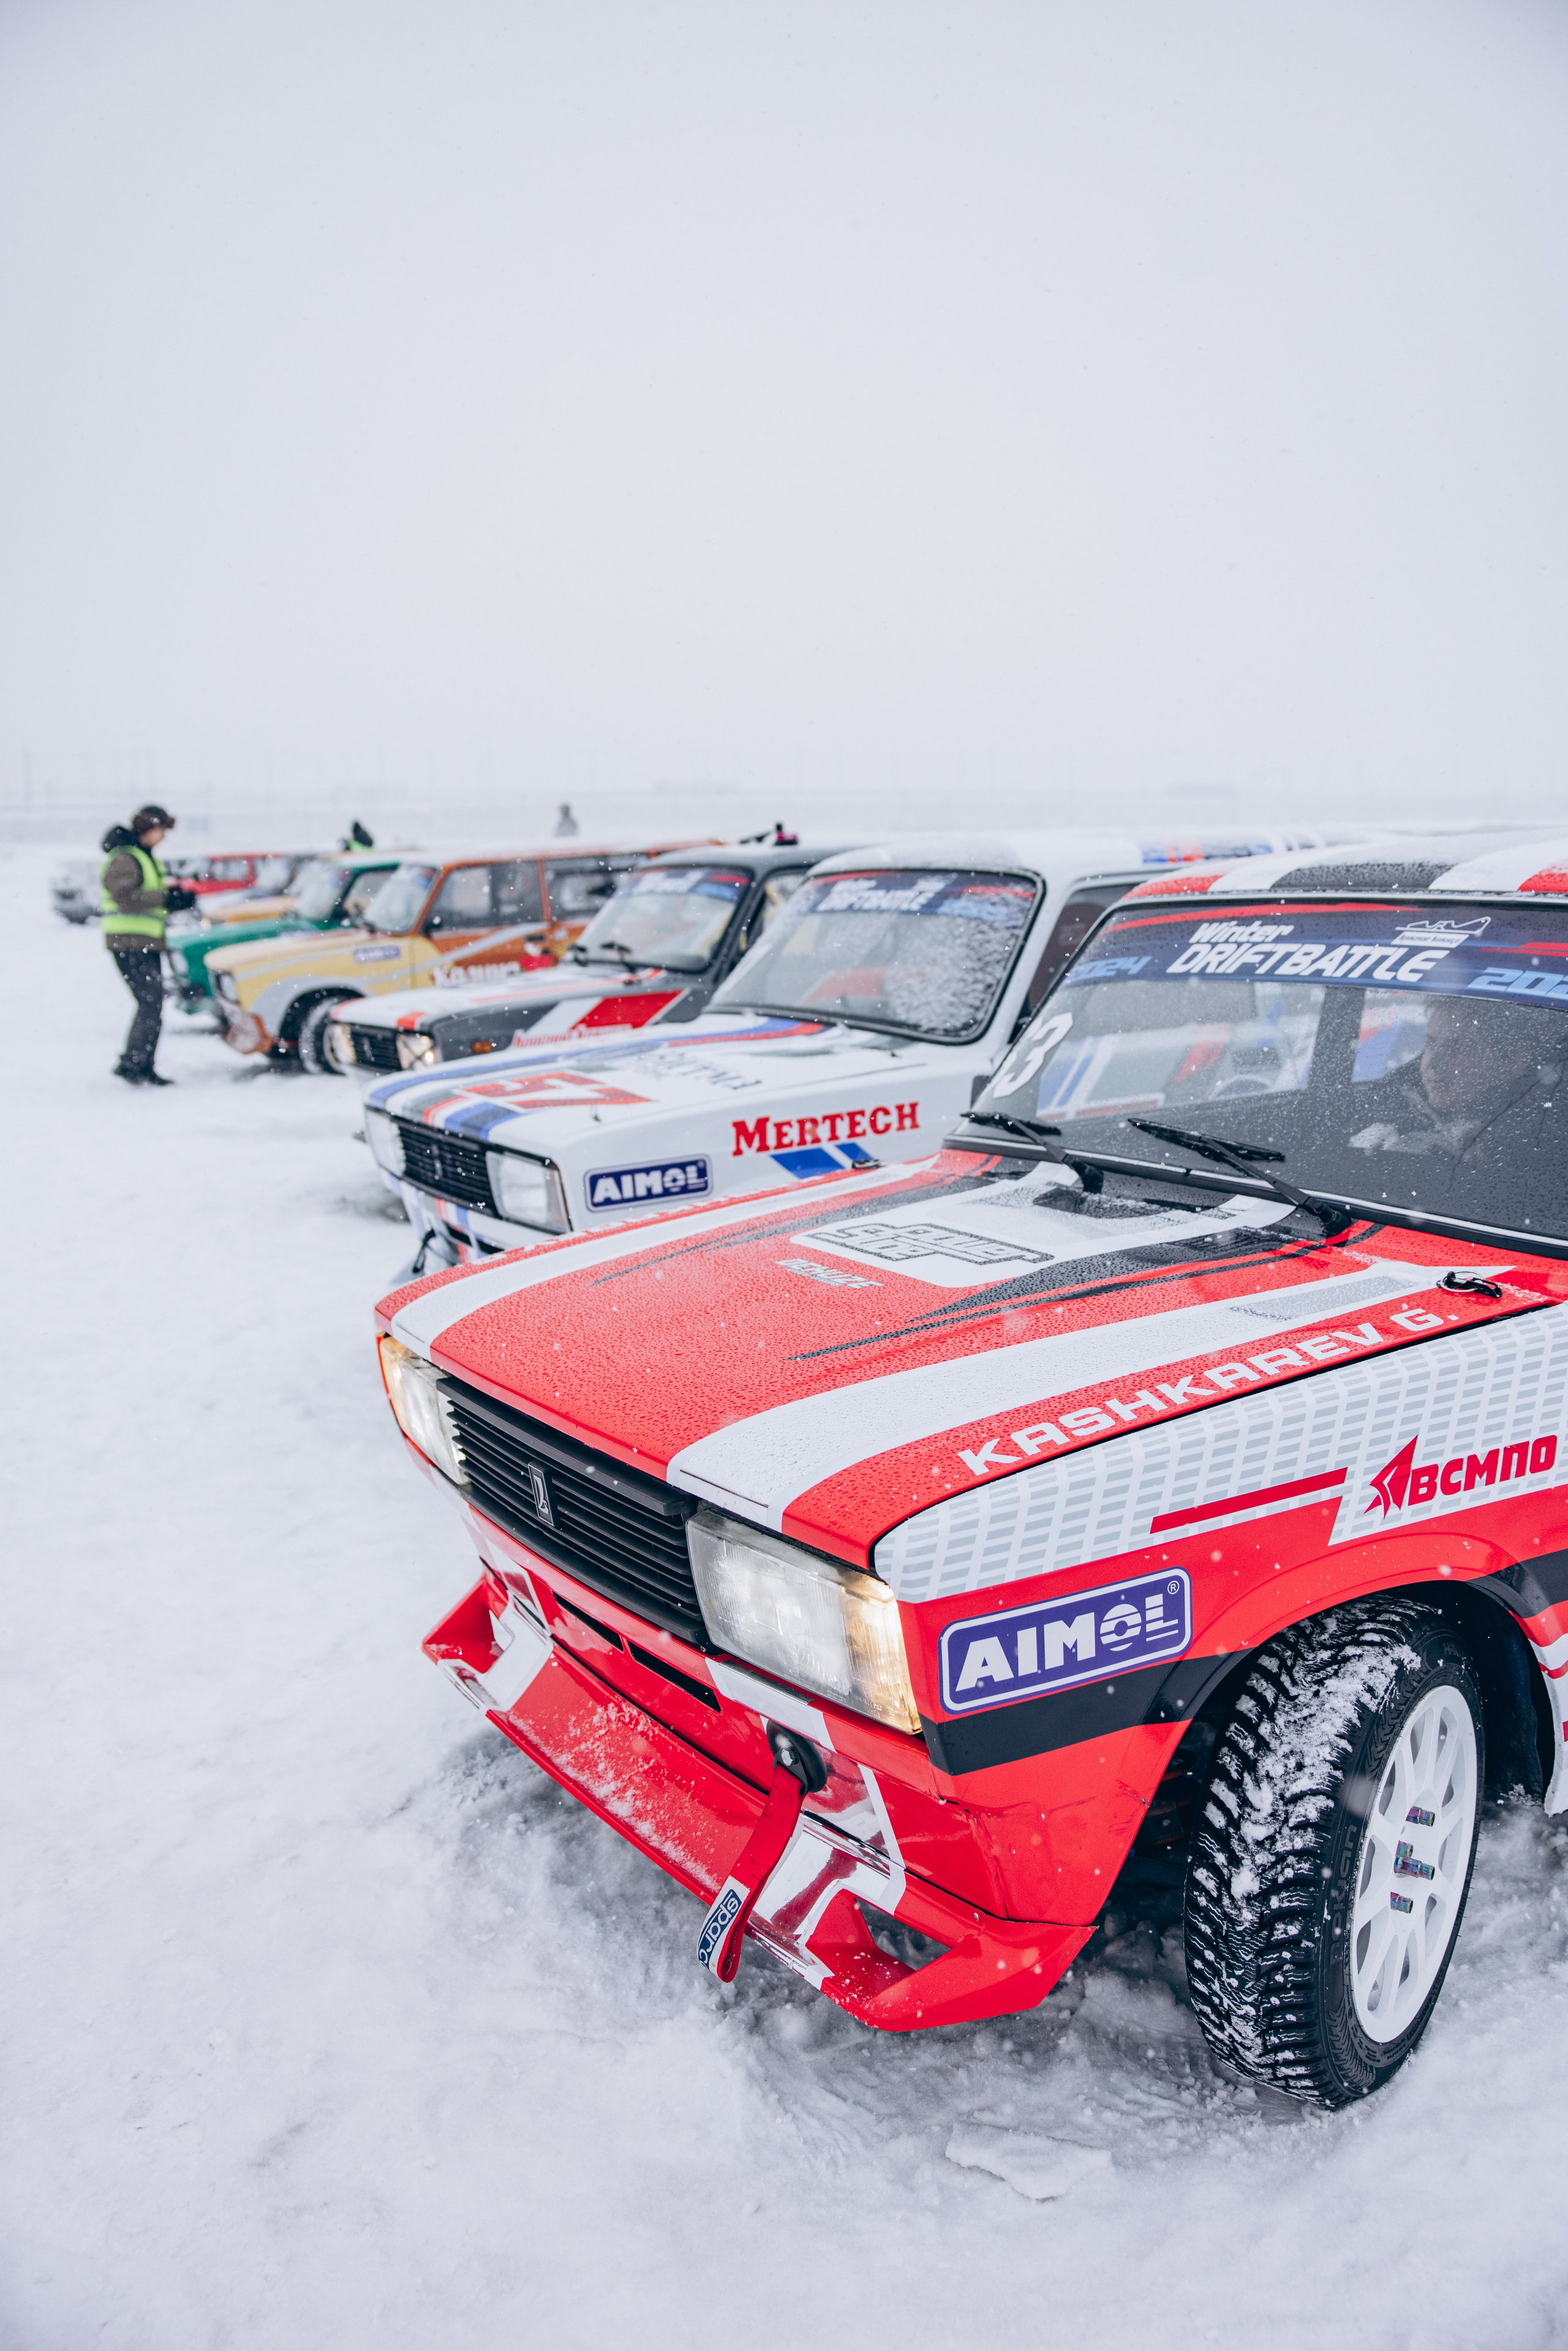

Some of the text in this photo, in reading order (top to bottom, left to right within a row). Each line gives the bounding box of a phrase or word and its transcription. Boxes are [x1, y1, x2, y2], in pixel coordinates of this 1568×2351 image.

[1189, 921, 1294, 943] Winter
[1166, 943, 1450, 982] DRIFTBATTLE
[731, 1101, 921, 1157] MERTECH
[593, 1164, 706, 1204] AIMOL
[957, 1307, 1460, 1476] KASHKAREV G.
[1408, 1434, 1558, 1506] ВСМПО
[956, 1593, 1179, 1692] AIMOL
